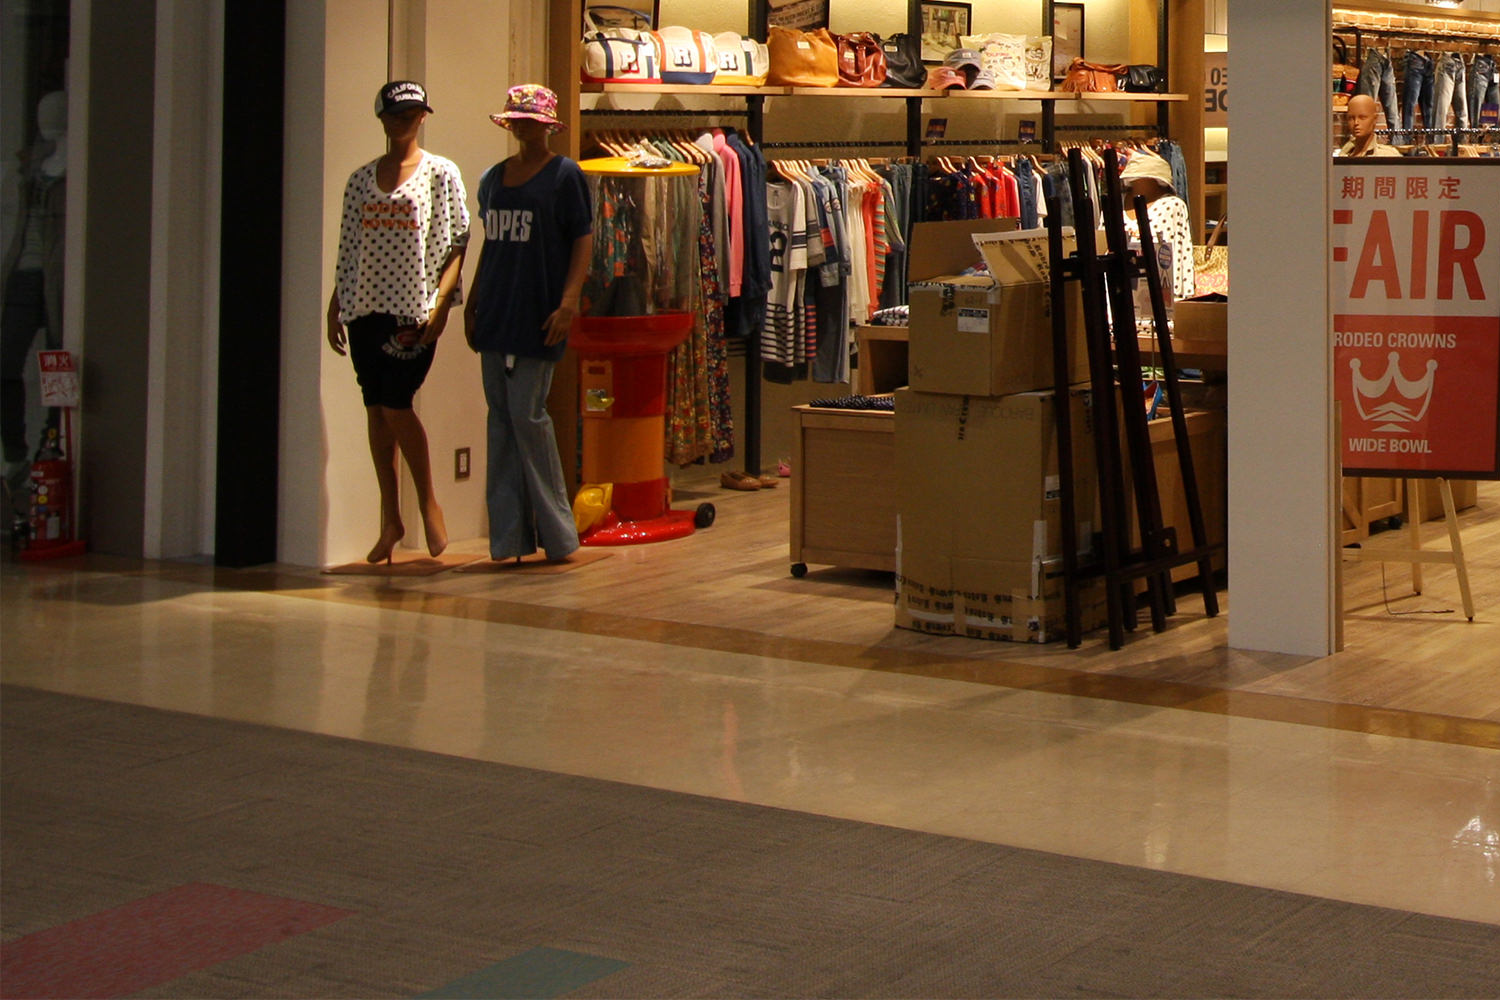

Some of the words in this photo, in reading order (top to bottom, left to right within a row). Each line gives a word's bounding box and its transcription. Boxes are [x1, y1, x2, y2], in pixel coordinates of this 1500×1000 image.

[1341, 175, 1462, 200] 期間限定
[486, 208, 534, 243] OPES
[1334, 331, 1384, 348] RODEO
[1387, 332, 1457, 349] CROWNS
[1348, 438, 1387, 453] WIDE
[1389, 438, 1433, 454] BOWL
